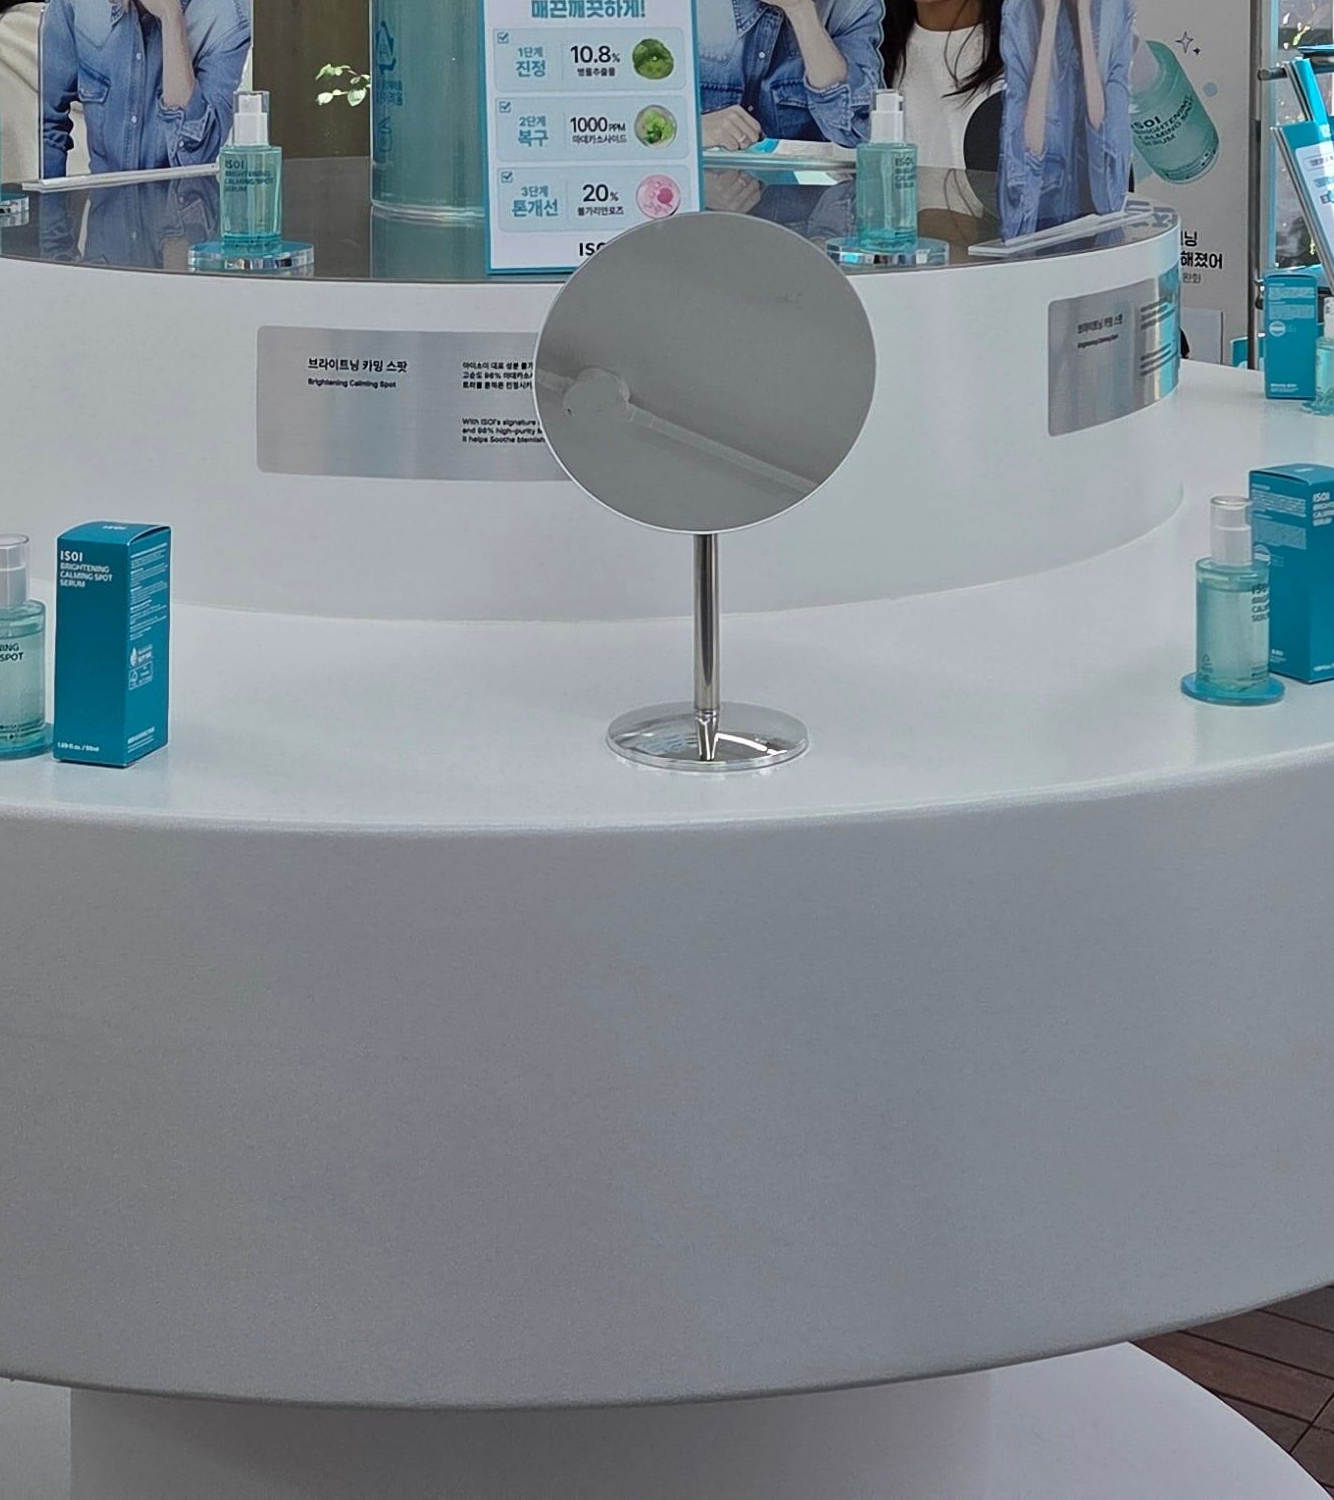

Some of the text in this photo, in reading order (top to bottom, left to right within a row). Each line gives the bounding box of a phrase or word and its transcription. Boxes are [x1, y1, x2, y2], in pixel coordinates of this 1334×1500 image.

[531, 0, 646, 19] 매끈깨끗하게!
[518, 46, 544, 60] 1단계
[570, 45, 621, 64] 10.8%
[516, 60, 547, 78] 진정
[519, 116, 547, 128] 2단계
[518, 129, 549, 147] 복구
[521, 185, 549, 198] 3단계
[582, 184, 619, 203] 20%
[511, 199, 559, 218] 톤개선
[308, 358, 407, 373] 브라이트닝 카밍 스팟
[60, 550, 83, 562] ISOI
[0, 652, 24, 662] SPOT
